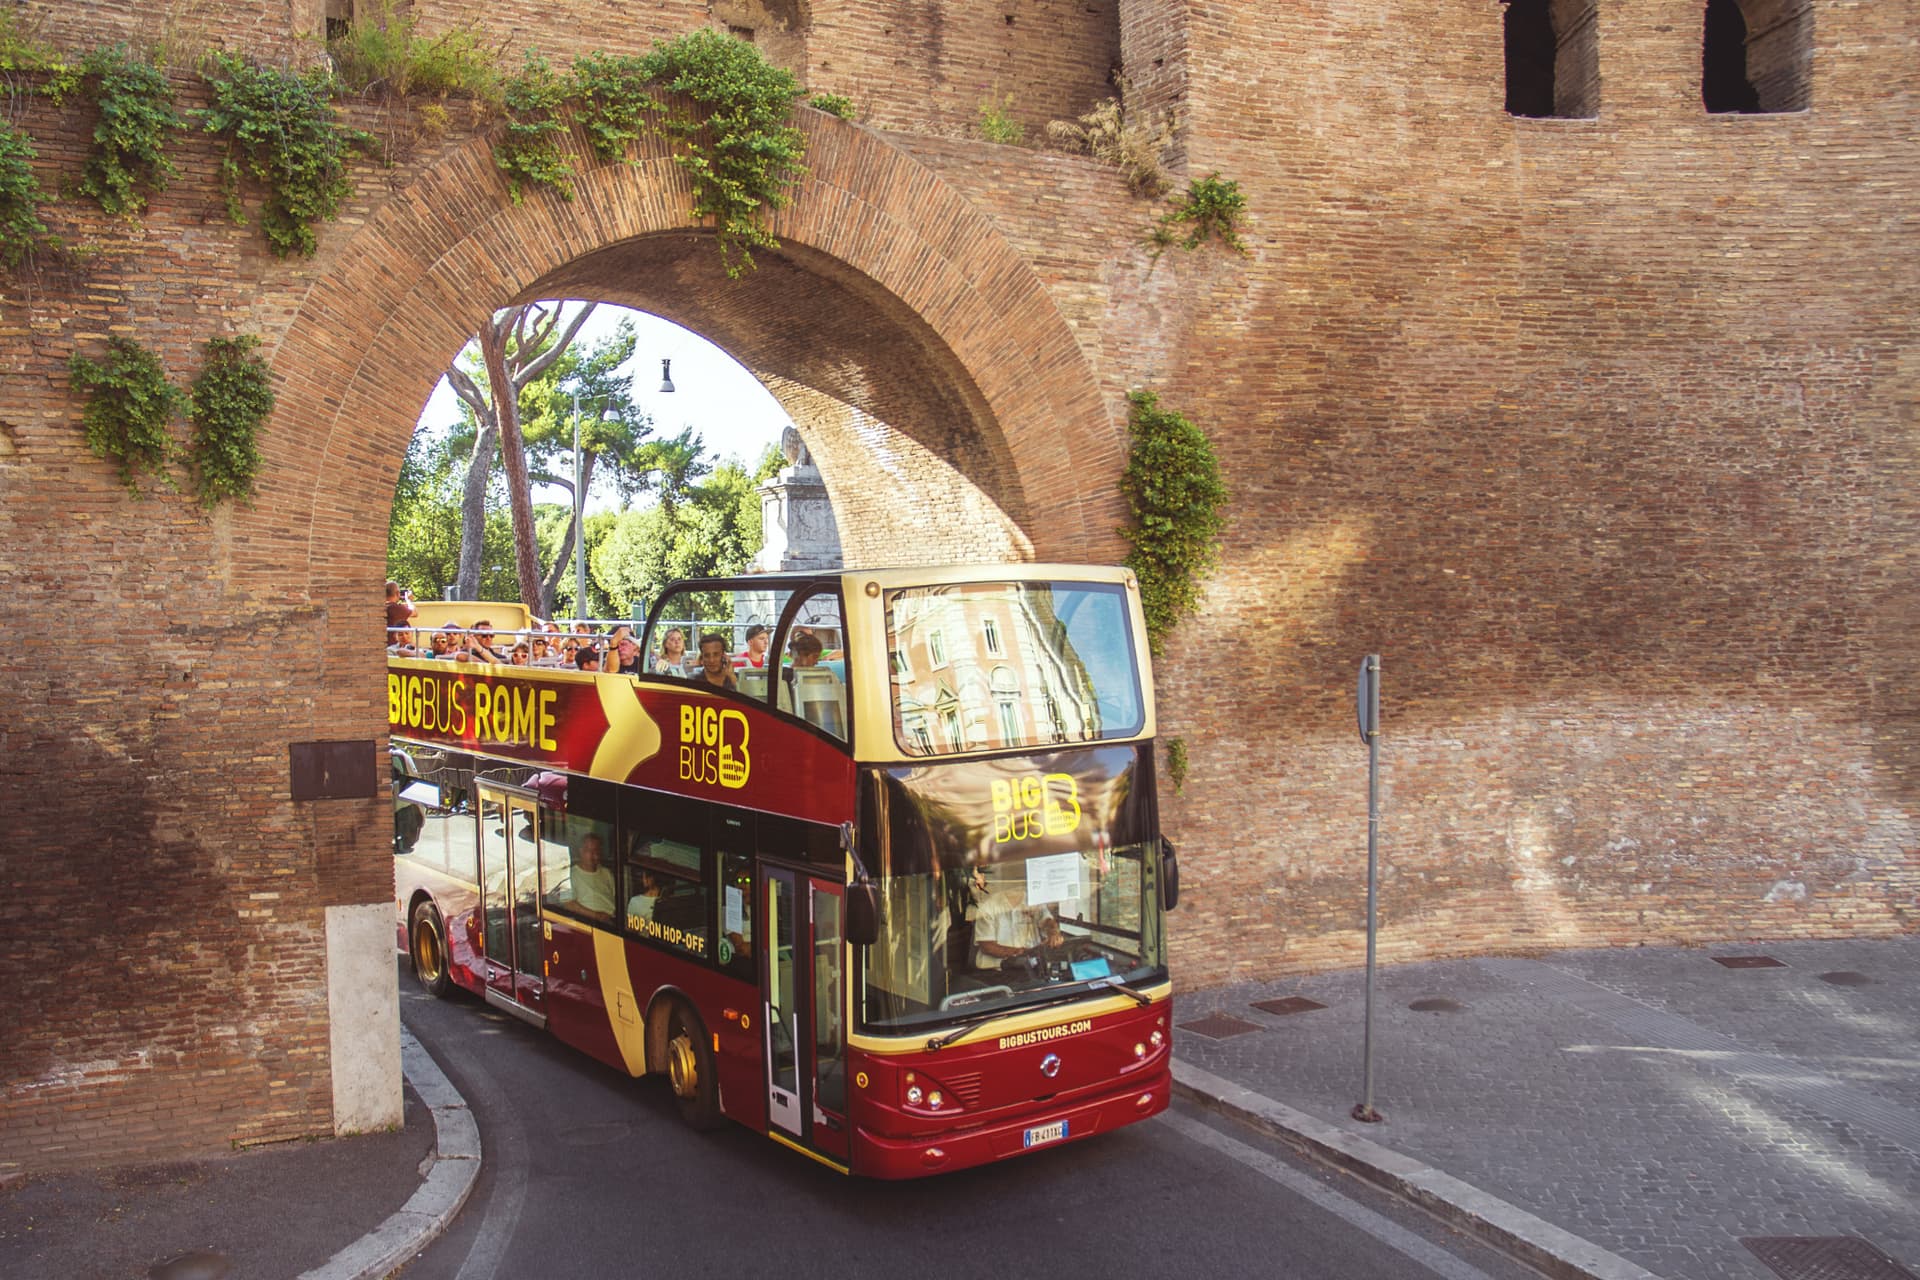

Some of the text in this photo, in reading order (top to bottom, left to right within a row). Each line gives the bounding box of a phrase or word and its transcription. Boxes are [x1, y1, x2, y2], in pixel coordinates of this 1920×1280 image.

[475, 683, 557, 751] ROME
[680, 704, 718, 746] BIG
[680, 745, 718, 785] BUS
[991, 776, 1041, 812] BIG
[995, 809, 1044, 843] BUS
[627, 913, 705, 952] HOP-ON HOP-OFF
[999, 1019, 1092, 1050] BIGBUSTOURS.COM
